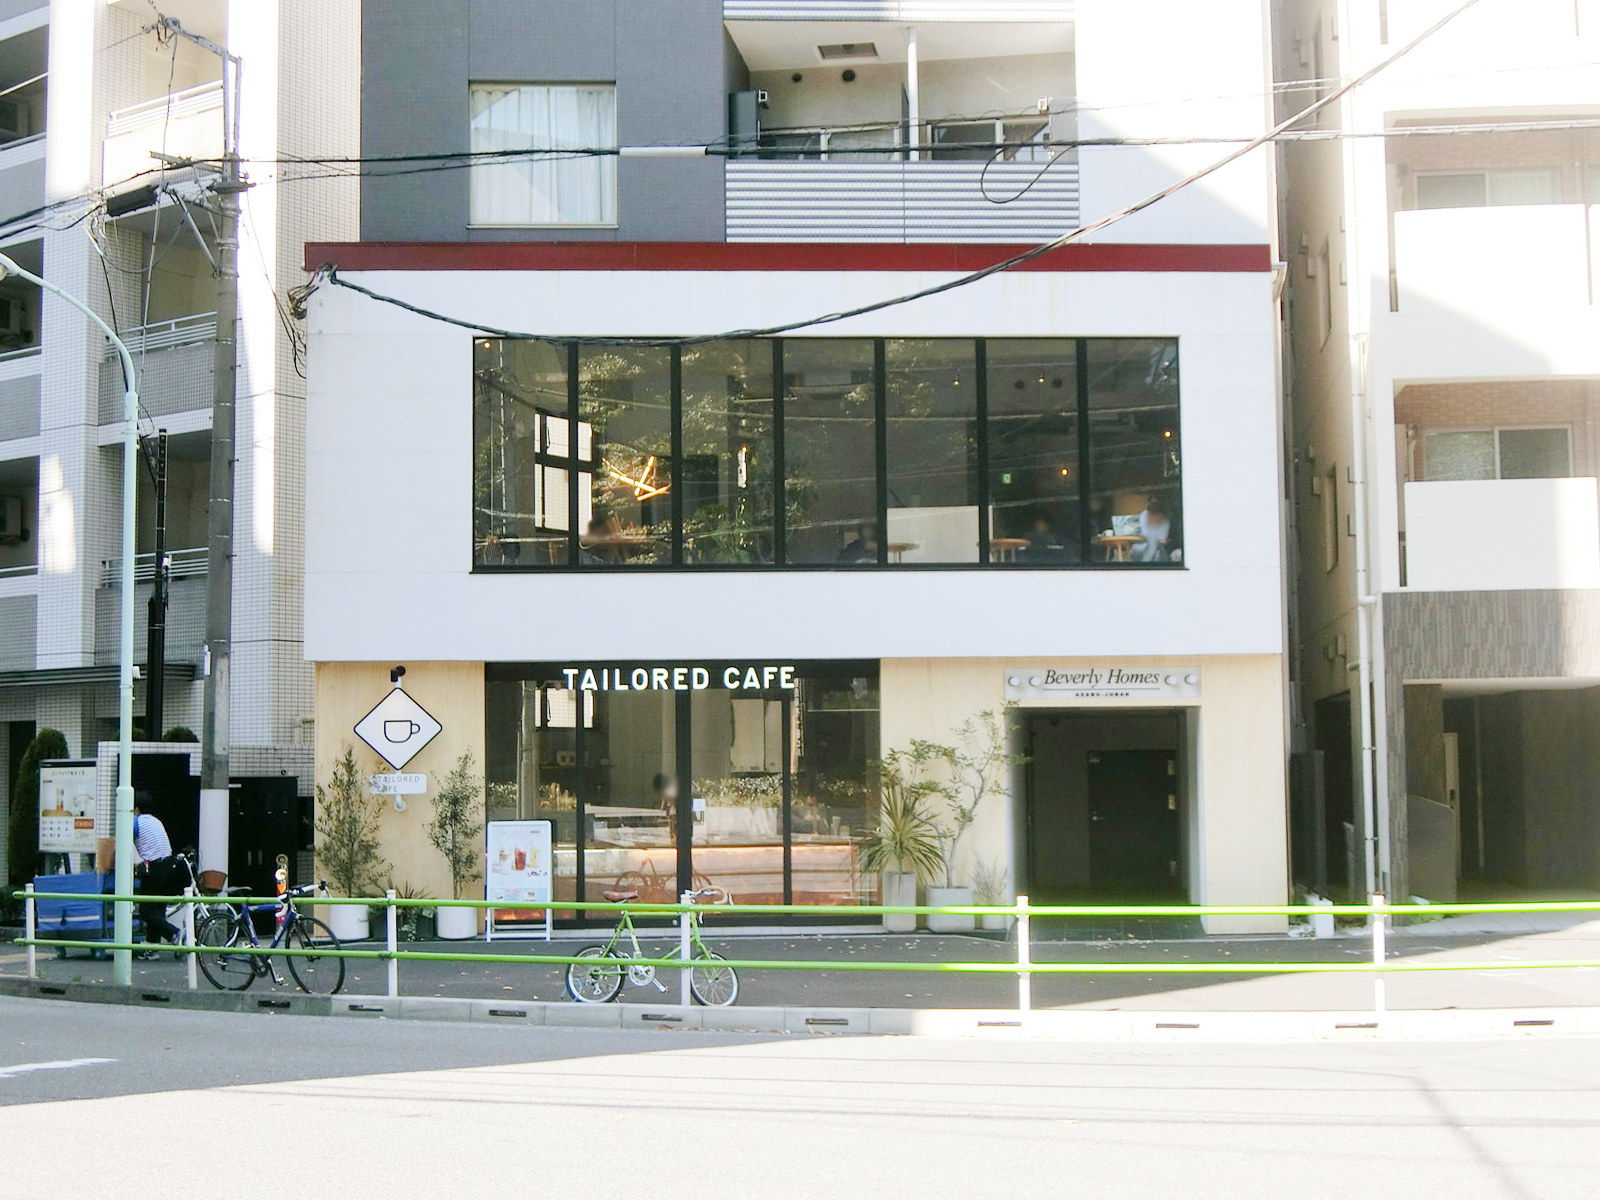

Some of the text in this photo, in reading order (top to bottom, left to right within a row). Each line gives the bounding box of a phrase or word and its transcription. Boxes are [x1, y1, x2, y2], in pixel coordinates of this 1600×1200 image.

[562, 666, 796, 691] TAILORED CAFE
[1044, 668, 1161, 689] Beverly Homes
